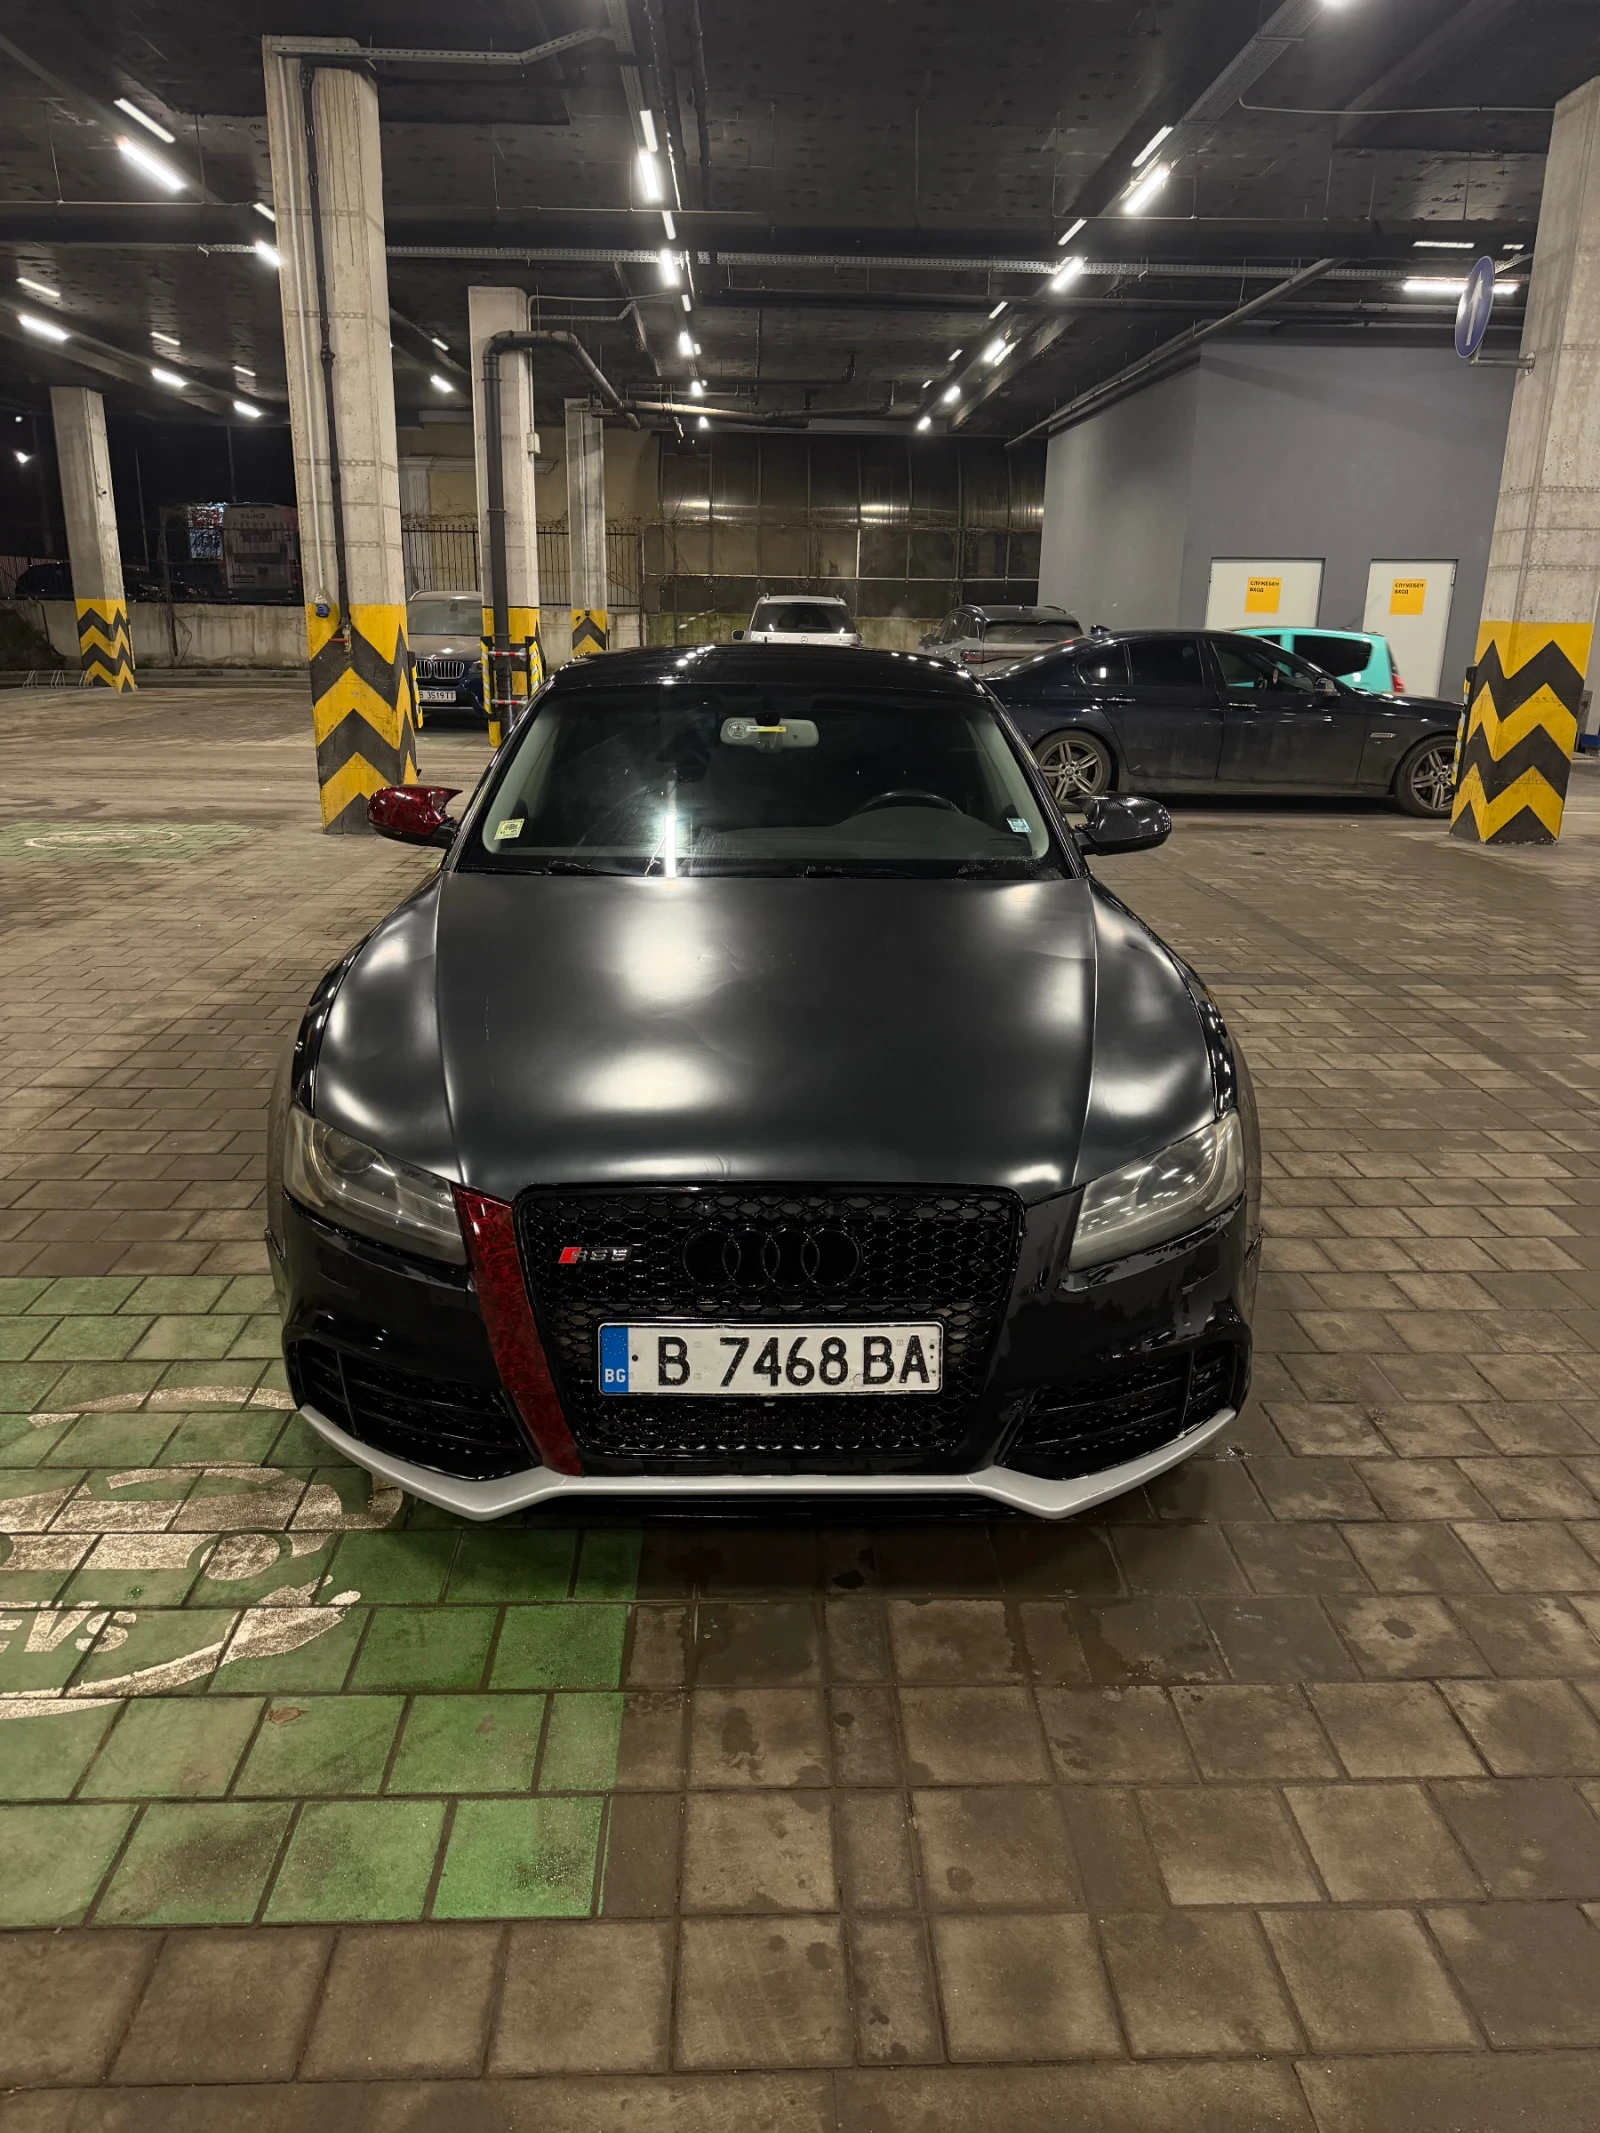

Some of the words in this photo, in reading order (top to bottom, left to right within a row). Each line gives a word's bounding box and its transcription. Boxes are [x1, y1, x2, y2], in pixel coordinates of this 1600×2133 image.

[604, 1367, 626, 1384] BG
[658, 1336, 691, 1386] B
[719, 1336, 849, 1387] 7468
[863, 1335, 930, 1385] BA
